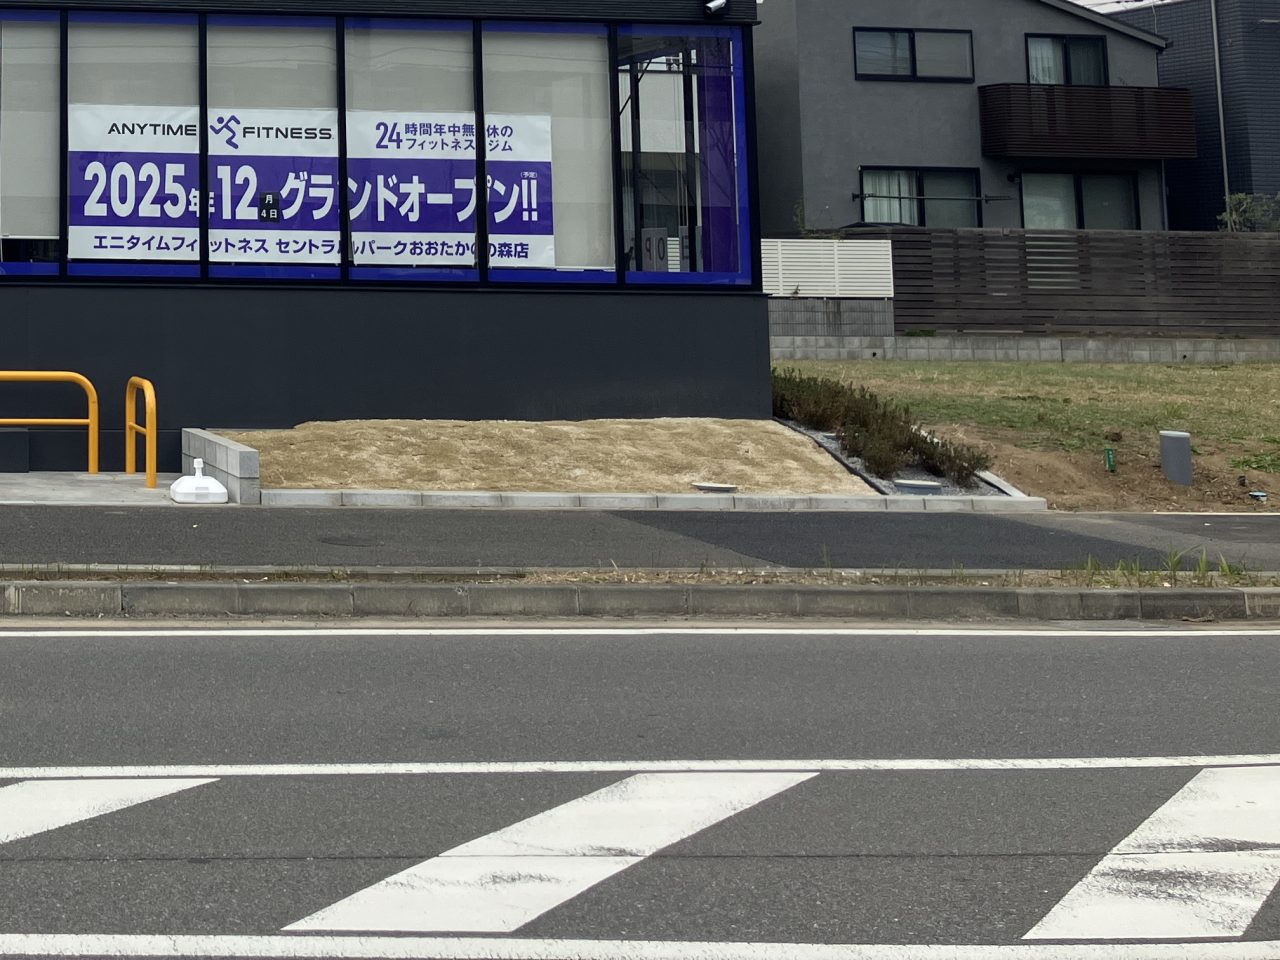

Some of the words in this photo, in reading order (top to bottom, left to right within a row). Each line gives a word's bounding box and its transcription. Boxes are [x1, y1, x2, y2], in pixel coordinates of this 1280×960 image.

[107, 122, 197, 136] ANYTIME
[242, 126, 333, 140] FITNESS
[93, 234, 269, 254] エニタイムフィットネス
